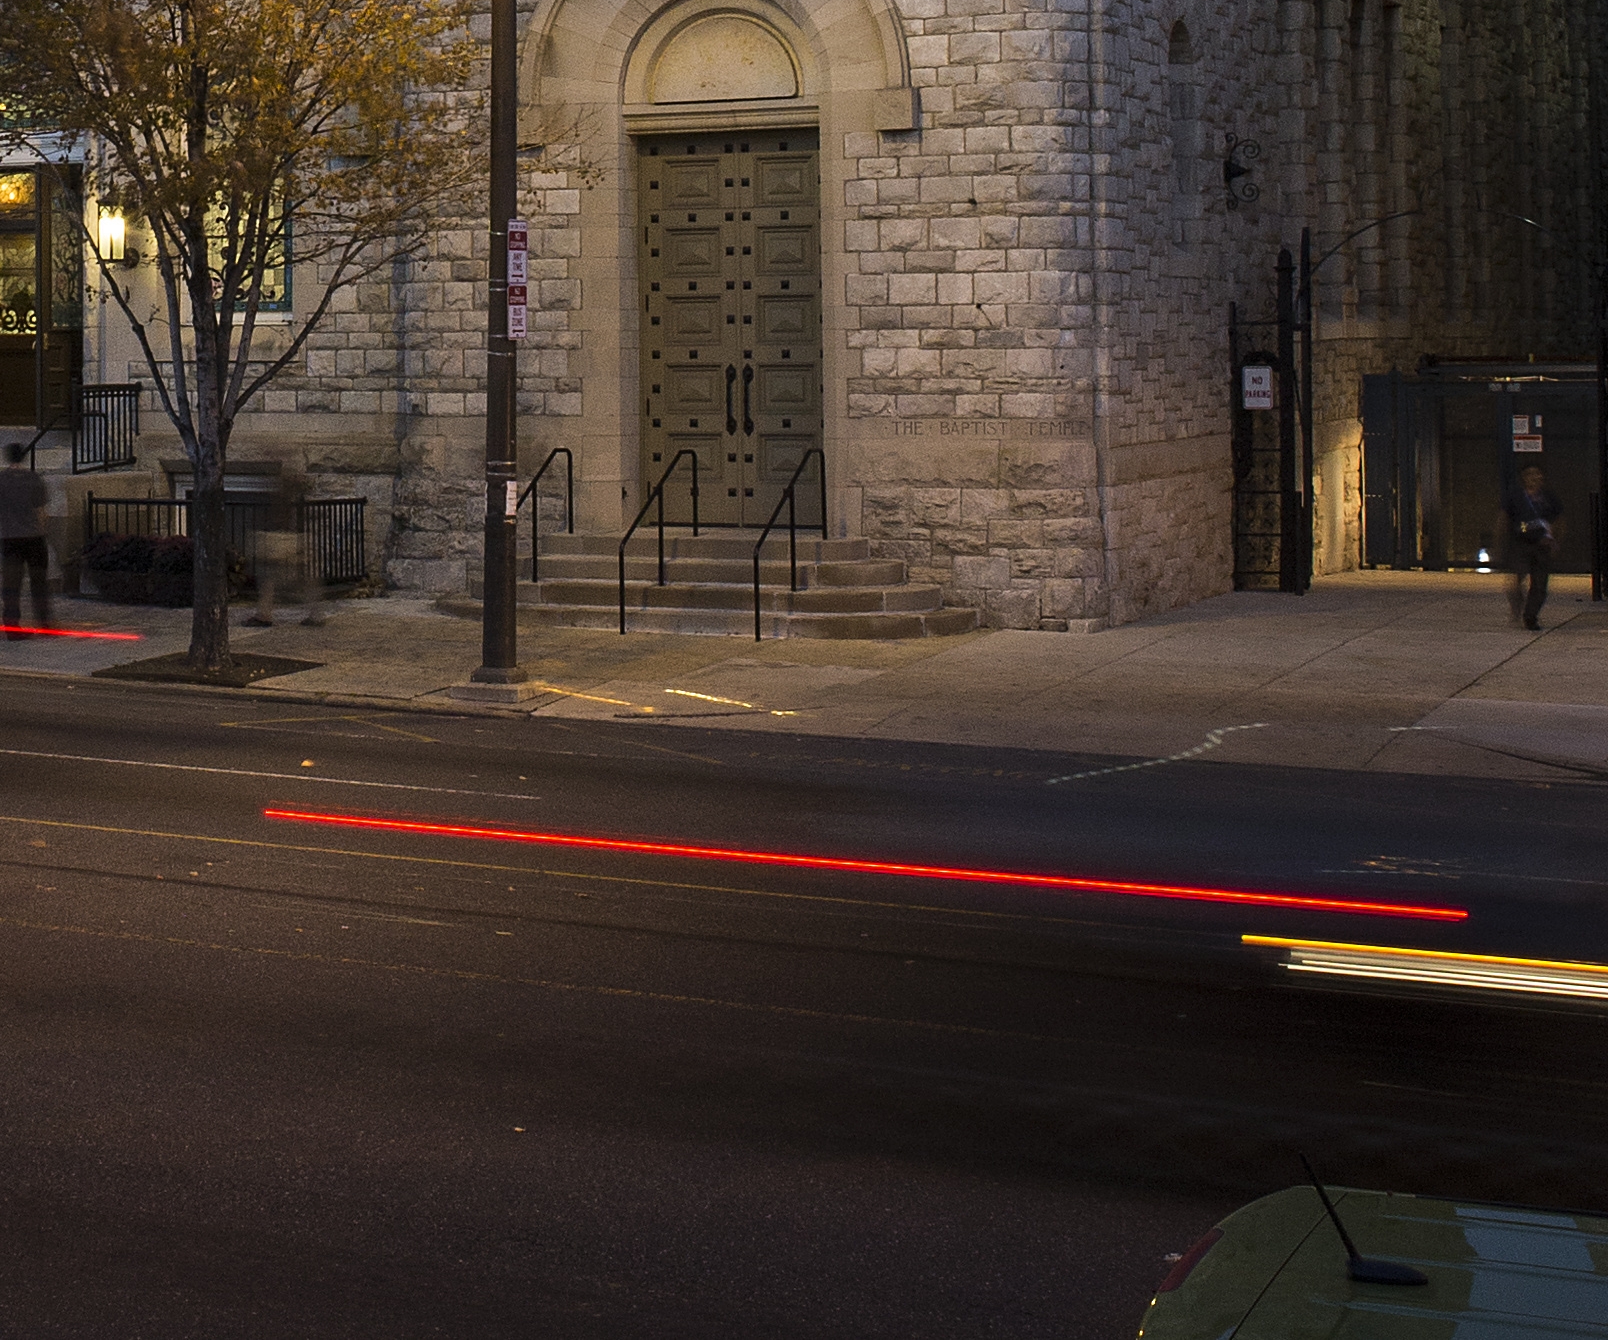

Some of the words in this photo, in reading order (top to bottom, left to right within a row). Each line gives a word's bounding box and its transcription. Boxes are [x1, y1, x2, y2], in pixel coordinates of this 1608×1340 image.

[1251, 376, 1264, 385] NO
[1245, 390, 1272, 398] PARKING
[892, 421, 924, 436] THE
[940, 421, 1008, 436] BAPTIST
[1027, 421, 1086, 436] TEMPLE
